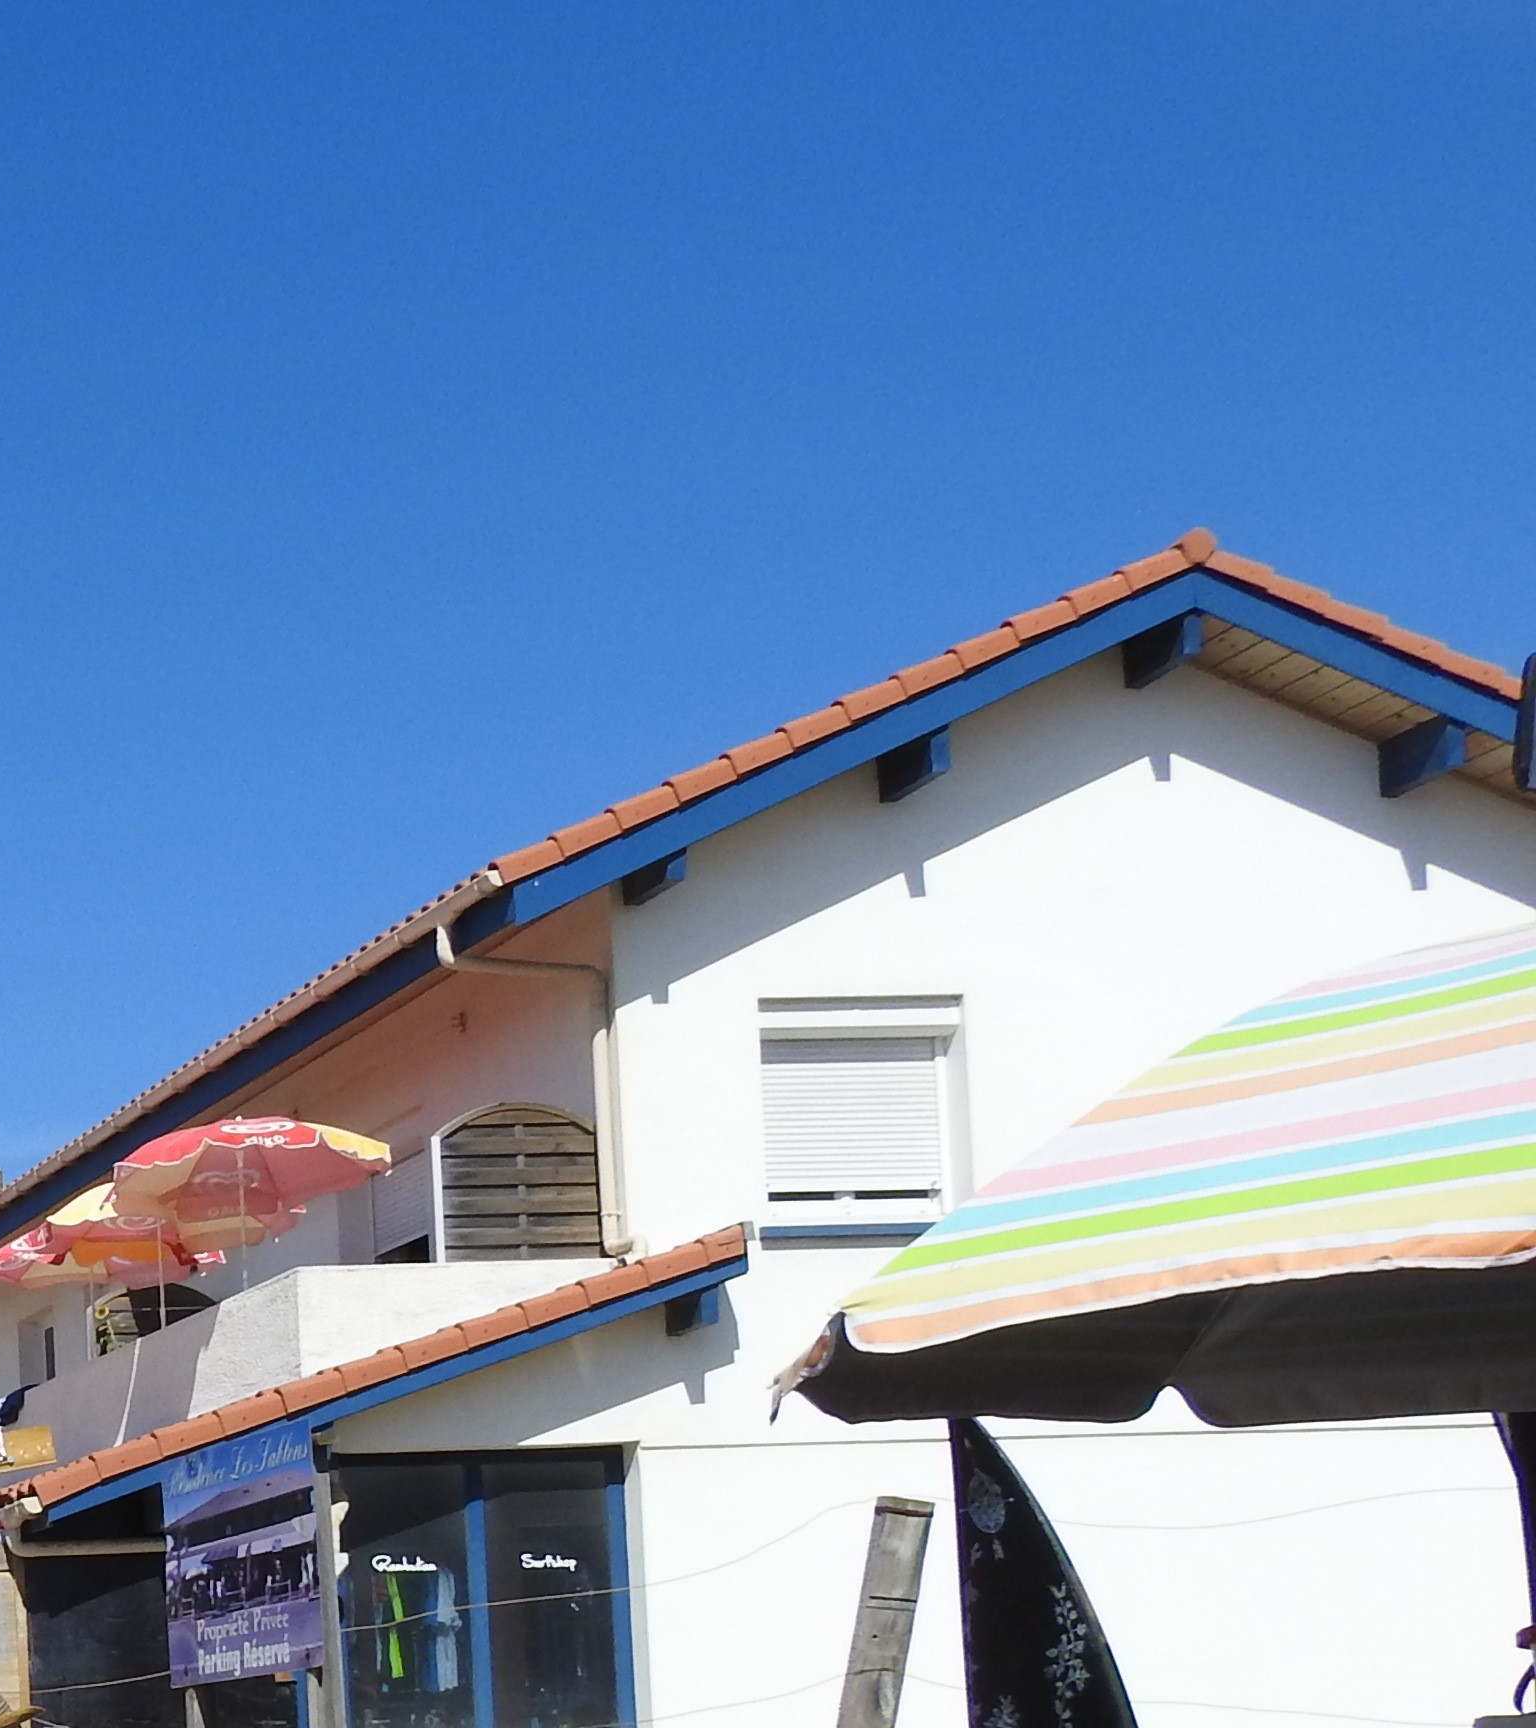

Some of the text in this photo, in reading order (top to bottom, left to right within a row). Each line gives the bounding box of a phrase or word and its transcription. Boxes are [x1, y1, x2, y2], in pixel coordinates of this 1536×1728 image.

[253, 1606, 289, 1632] Privée
[198, 1633, 290, 1677] Parking Réservé
